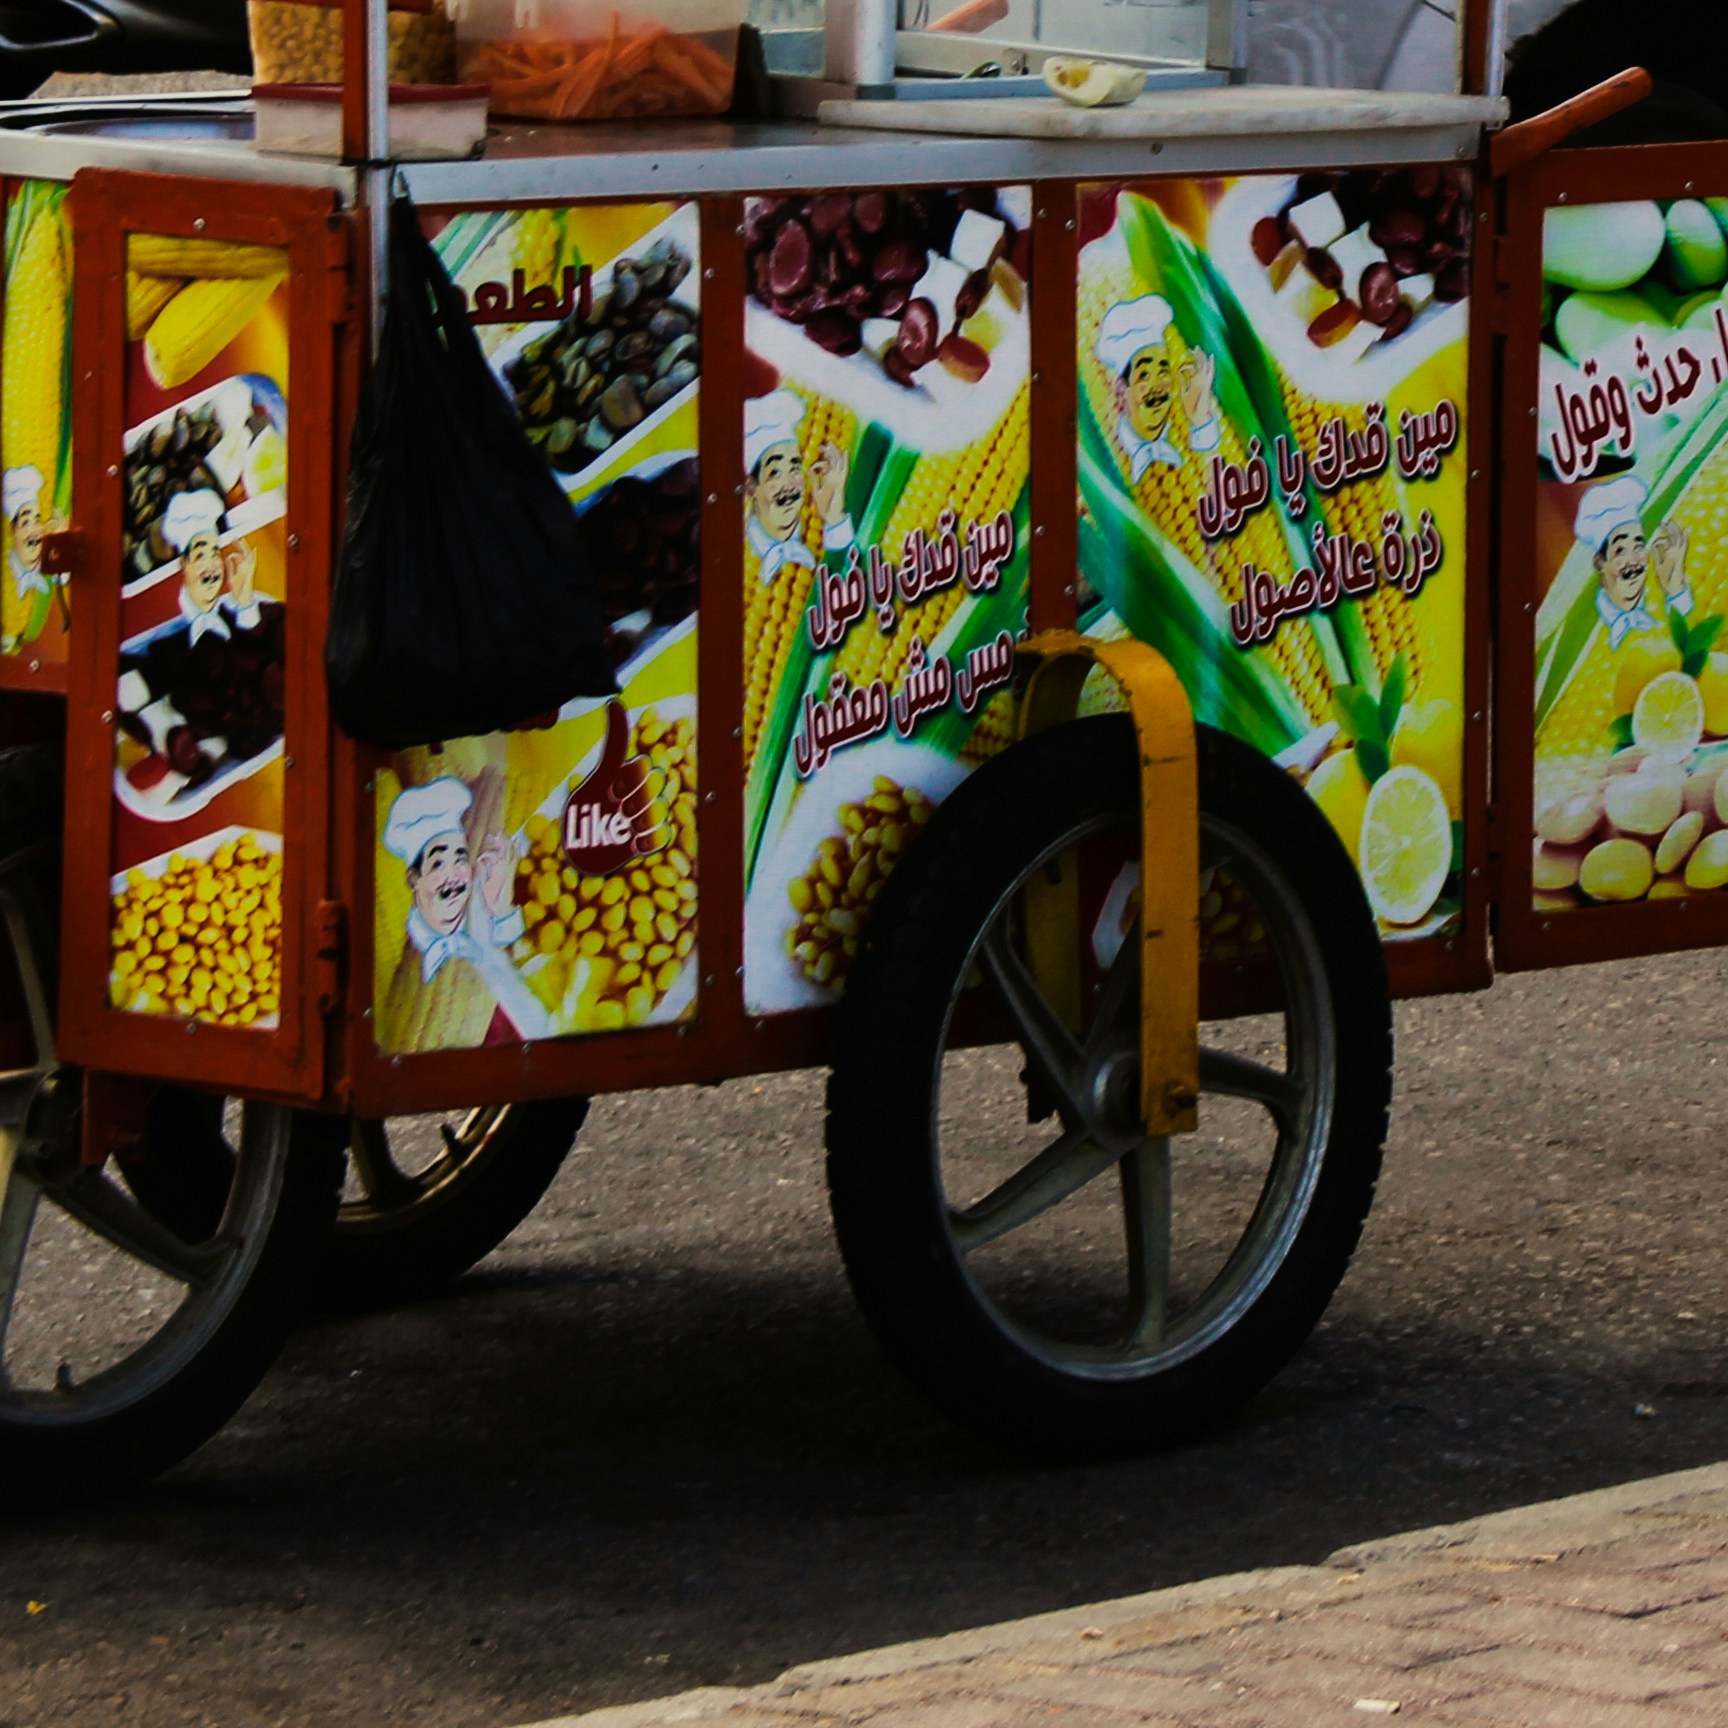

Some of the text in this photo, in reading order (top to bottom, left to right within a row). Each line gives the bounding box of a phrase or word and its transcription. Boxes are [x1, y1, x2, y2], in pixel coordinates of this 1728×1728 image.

[1550, 357, 1632, 477] وقول
[1636, 335, 1701, 415] حدث
[1197, 398, 1457, 537] مين قدك يا فول
[808, 509, 1013, 650] مين قدك يا فول
[1229, 508, 1442, 645] ذرة عالأصول
[793, 671, 888, 777] معقول
[891, 635, 951, 738] مش
[565, 802, 632, 849] Like
